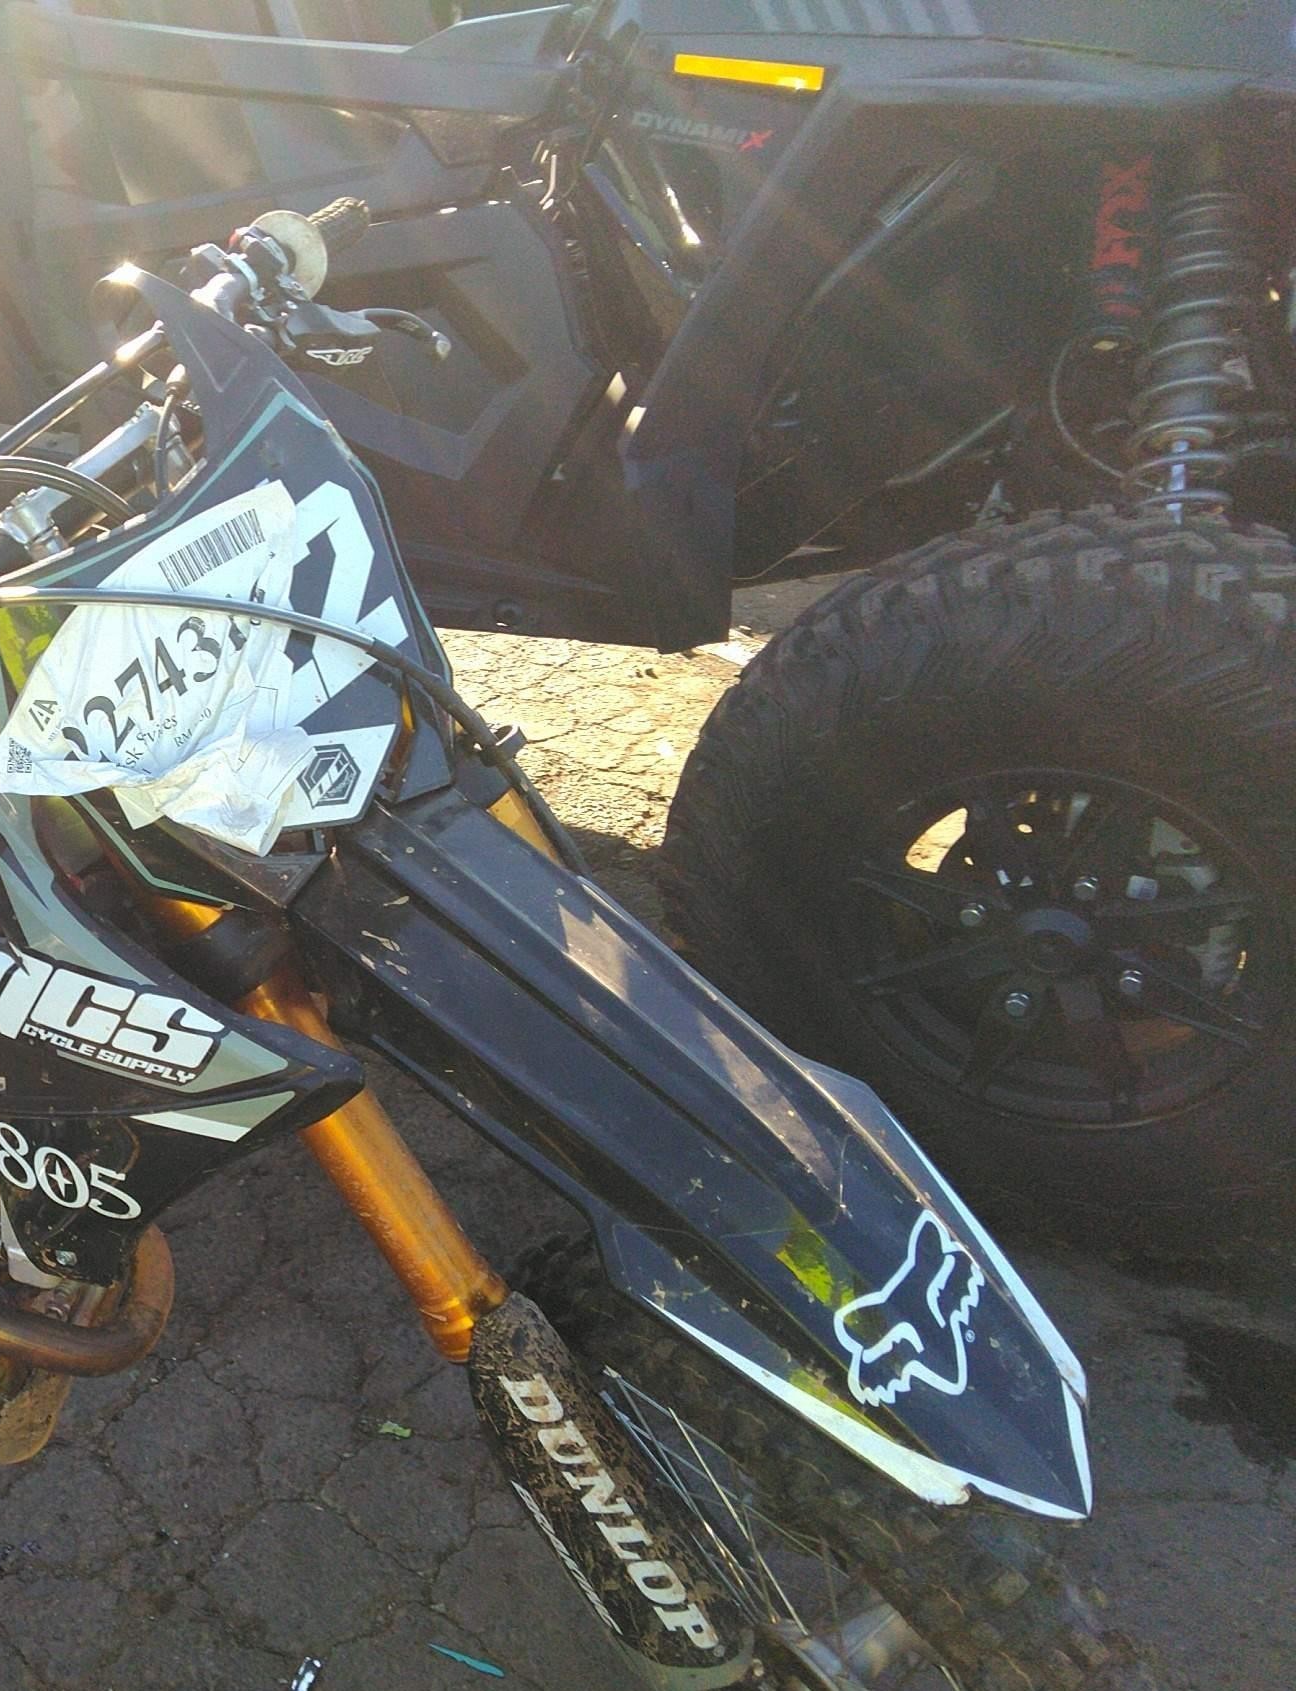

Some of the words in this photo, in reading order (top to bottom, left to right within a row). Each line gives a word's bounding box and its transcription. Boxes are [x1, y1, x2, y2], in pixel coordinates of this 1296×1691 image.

[22, 1022, 95, 1057] CYCLE
[96, 1048, 197, 1085] SUPPLY
[498, 1373, 719, 1650] DUNLOP
